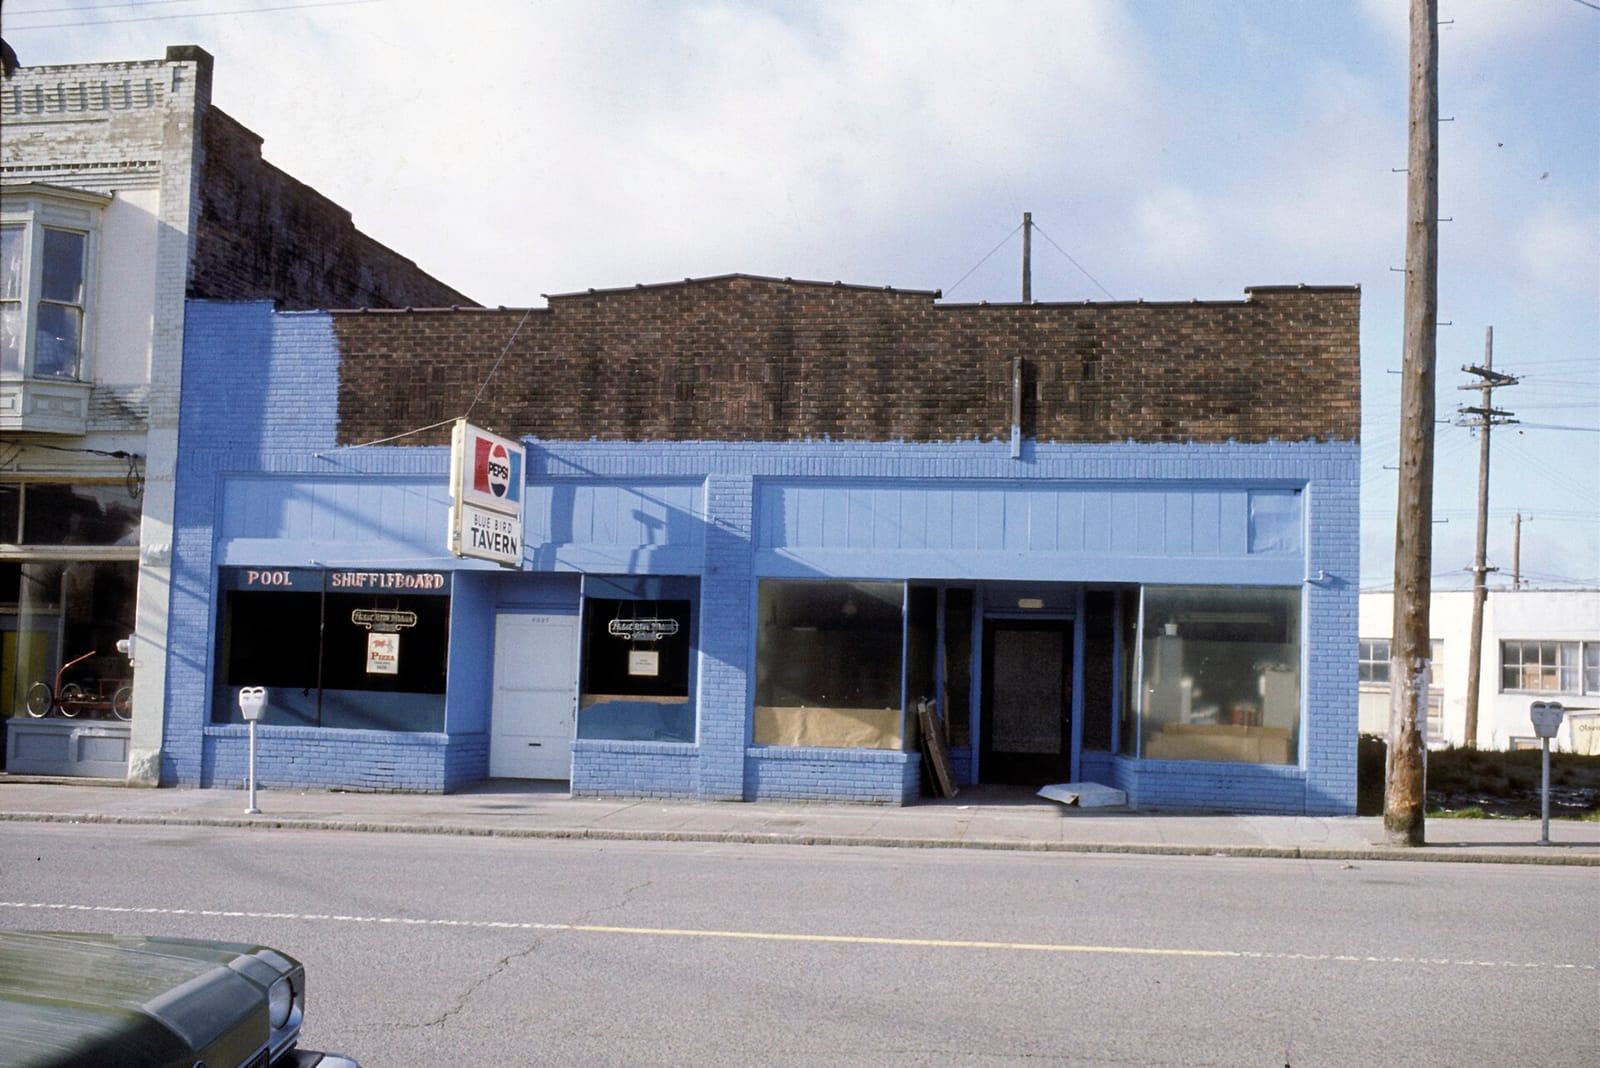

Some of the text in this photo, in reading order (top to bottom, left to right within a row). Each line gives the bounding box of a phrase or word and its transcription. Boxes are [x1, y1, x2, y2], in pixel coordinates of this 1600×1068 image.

[488, 461, 508, 480] PEPSI
[474, 513, 513, 534] BLUE BIRD
[471, 527, 518, 555] TAVERN
[247, 570, 293, 586] POOL
[332, 572, 444, 589] SHUFFLEBOARD
